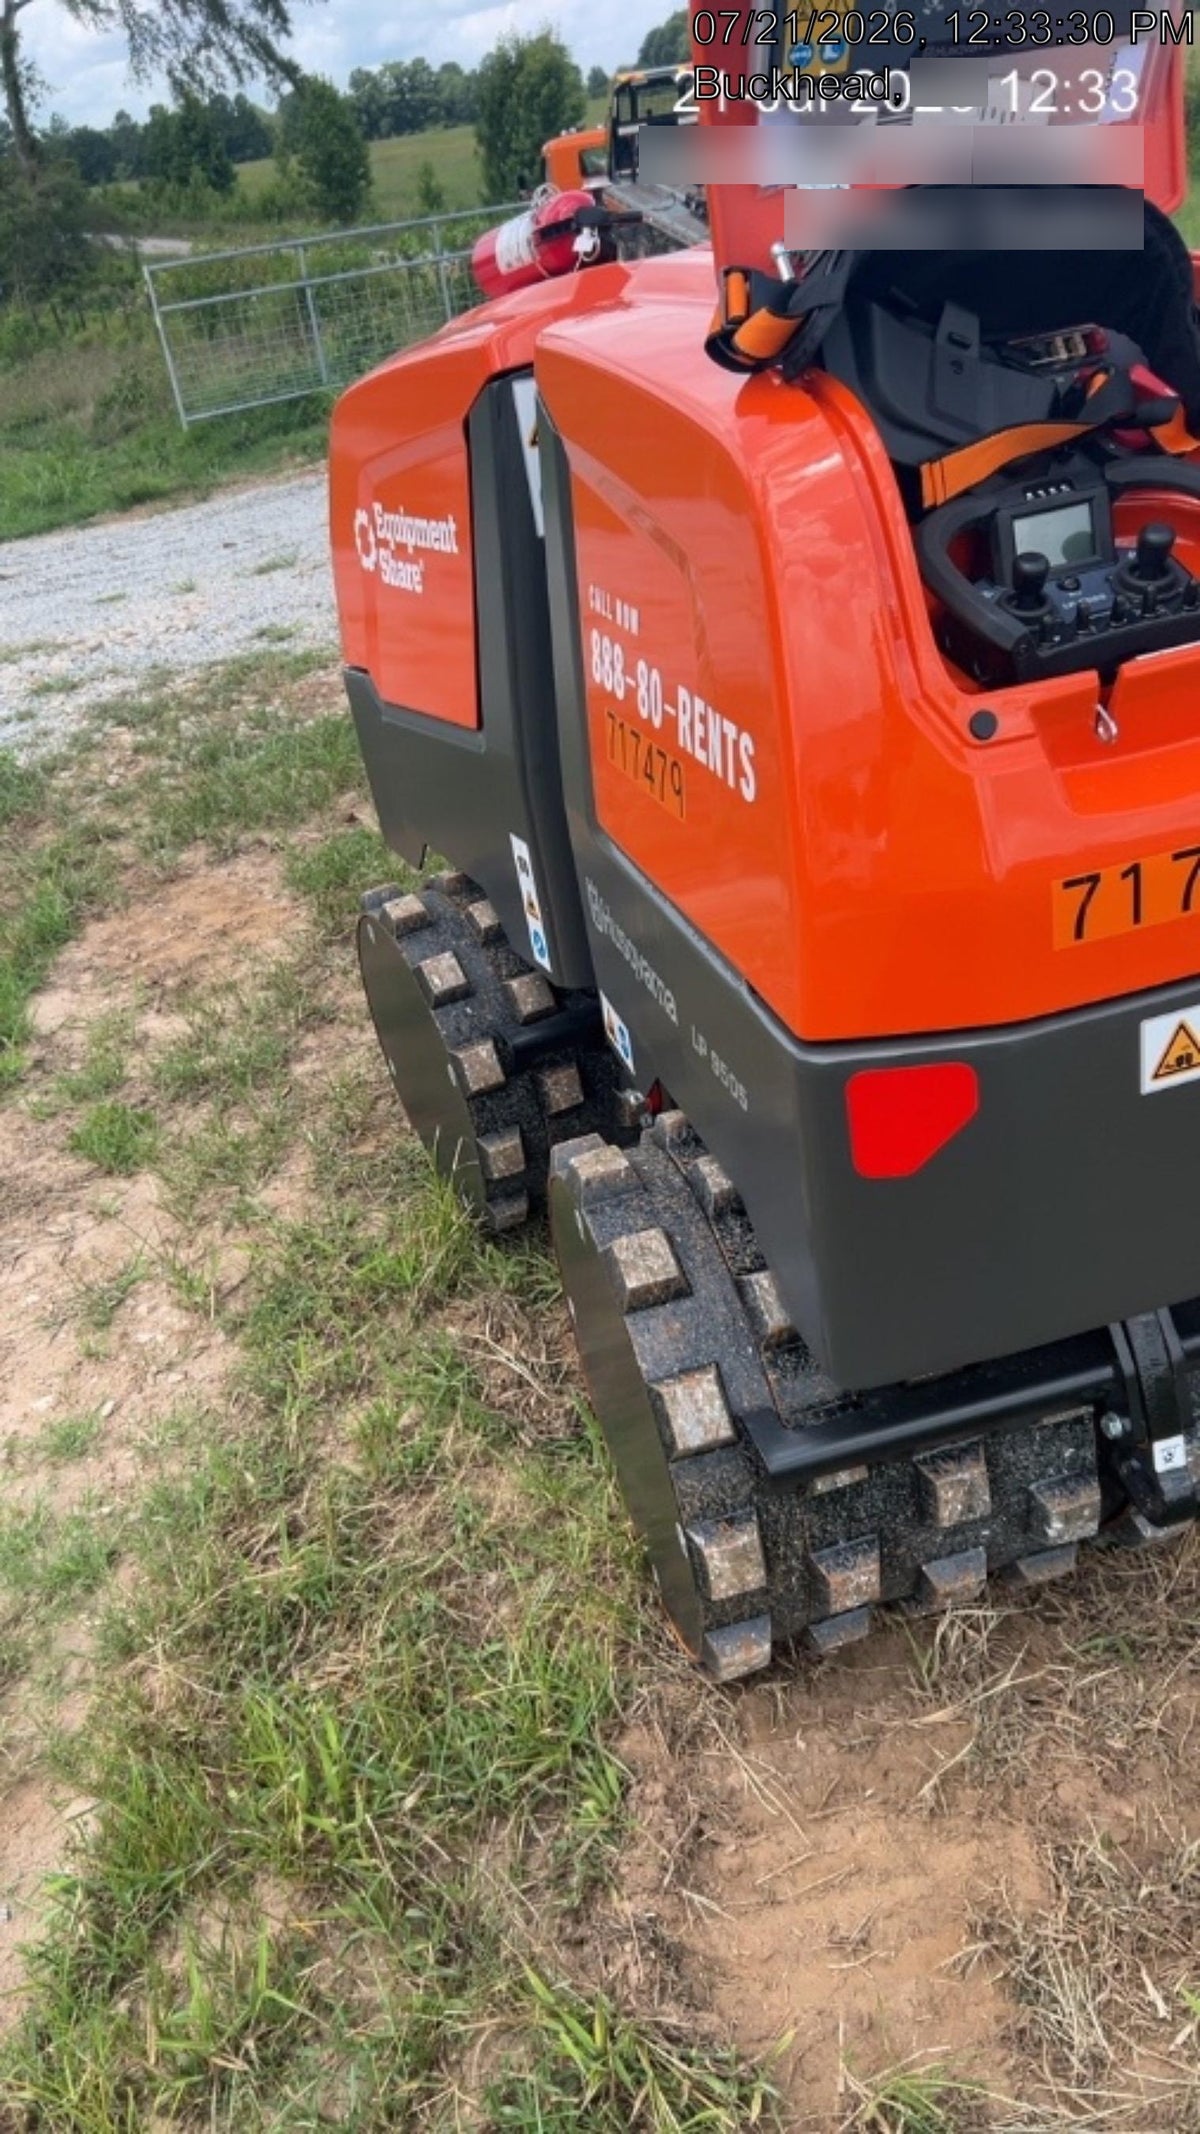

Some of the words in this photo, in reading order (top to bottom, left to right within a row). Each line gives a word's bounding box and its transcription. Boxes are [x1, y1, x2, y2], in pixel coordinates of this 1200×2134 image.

[372, 501, 459, 555] Equipment
[589, 584, 613, 620] CALL
[591, 628, 756, 803] 888-80-RENTS
[606, 711, 684, 820] 717479
